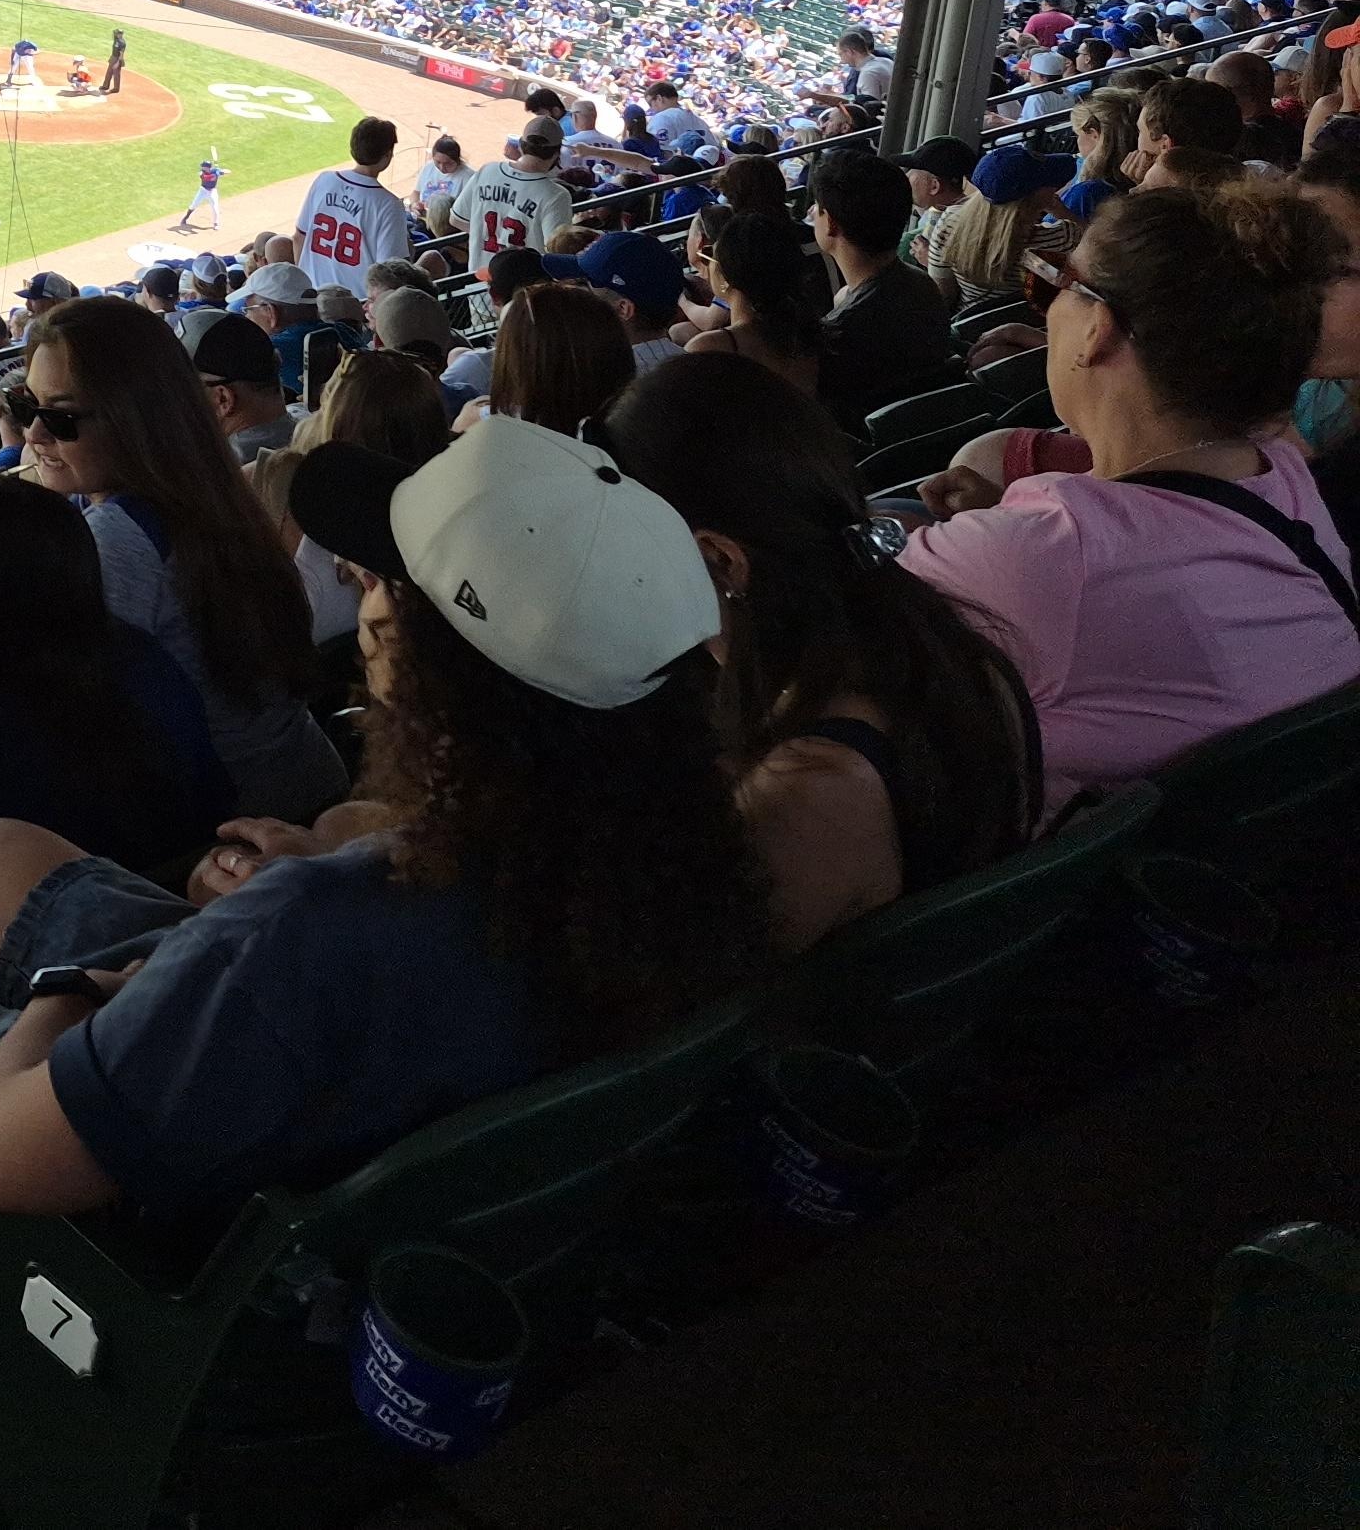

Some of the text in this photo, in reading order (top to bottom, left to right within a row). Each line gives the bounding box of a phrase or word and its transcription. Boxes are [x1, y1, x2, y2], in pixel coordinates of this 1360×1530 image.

[207, 83, 335, 123] 23
[325, 192, 363, 218] OLSON
[479, 183, 517, 207] ACUÑA
[311, 212, 362, 267] 28
[49, 1298, 73, 1340] 7
[369, 1360, 423, 1413] Hefty
[380, 1407, 446, 1448] Hefty
